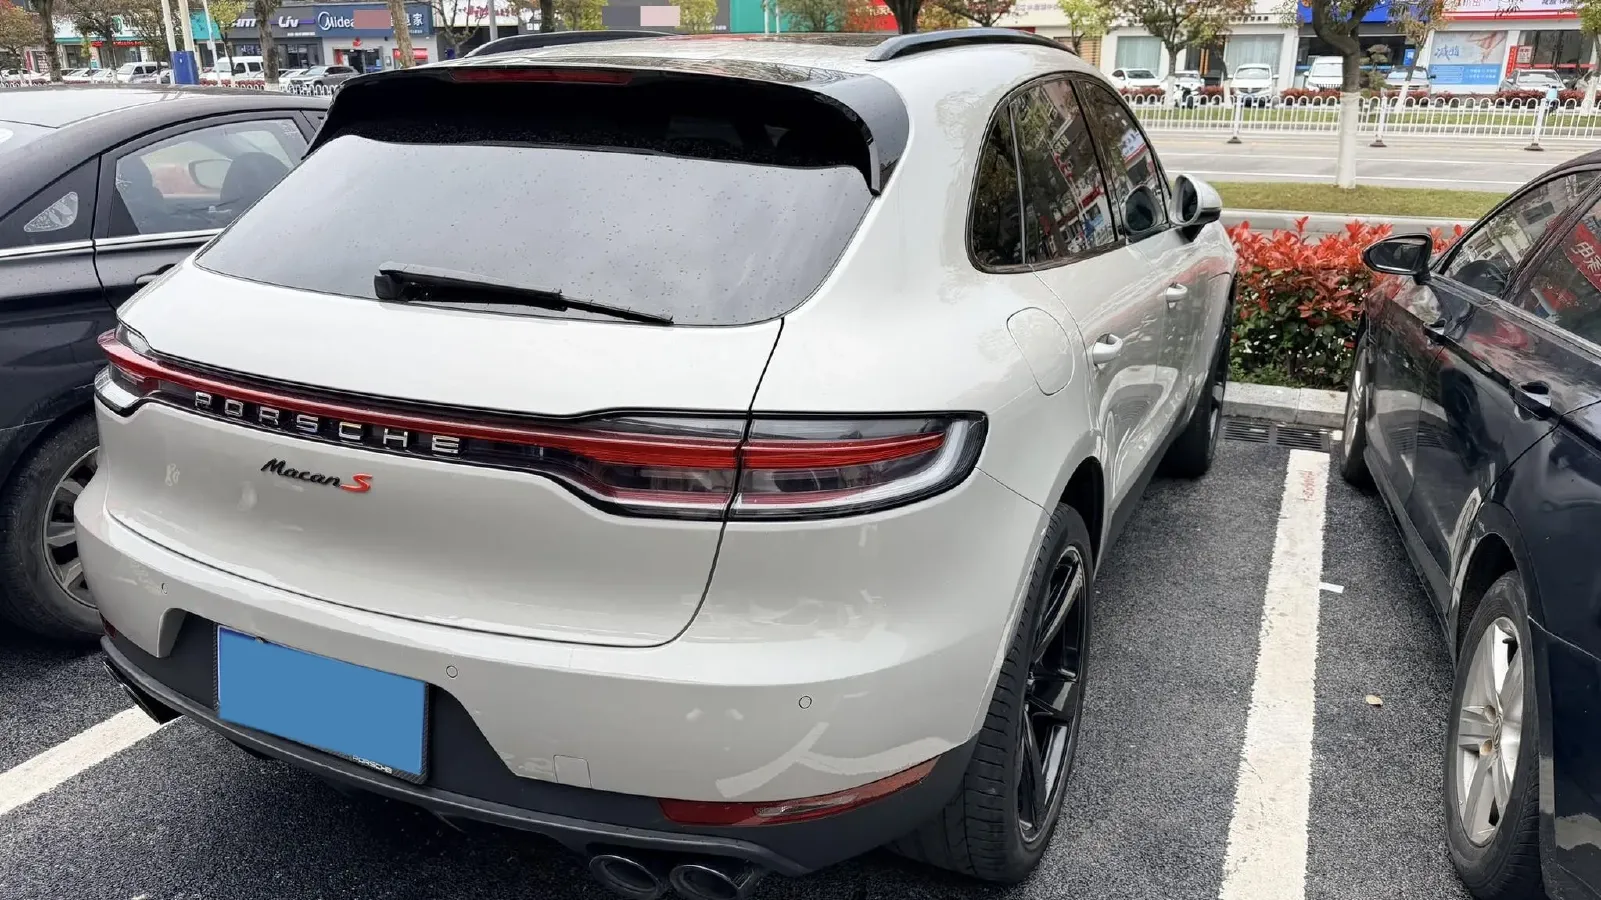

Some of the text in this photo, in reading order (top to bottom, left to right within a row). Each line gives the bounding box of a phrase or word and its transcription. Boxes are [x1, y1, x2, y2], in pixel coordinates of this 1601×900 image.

[278, 15, 300, 28] Liv
[194, 391, 461, 455] PORSCHE
[260, 458, 373, 493] Macan S
[352, 754, 393, 774] PORSCHE
